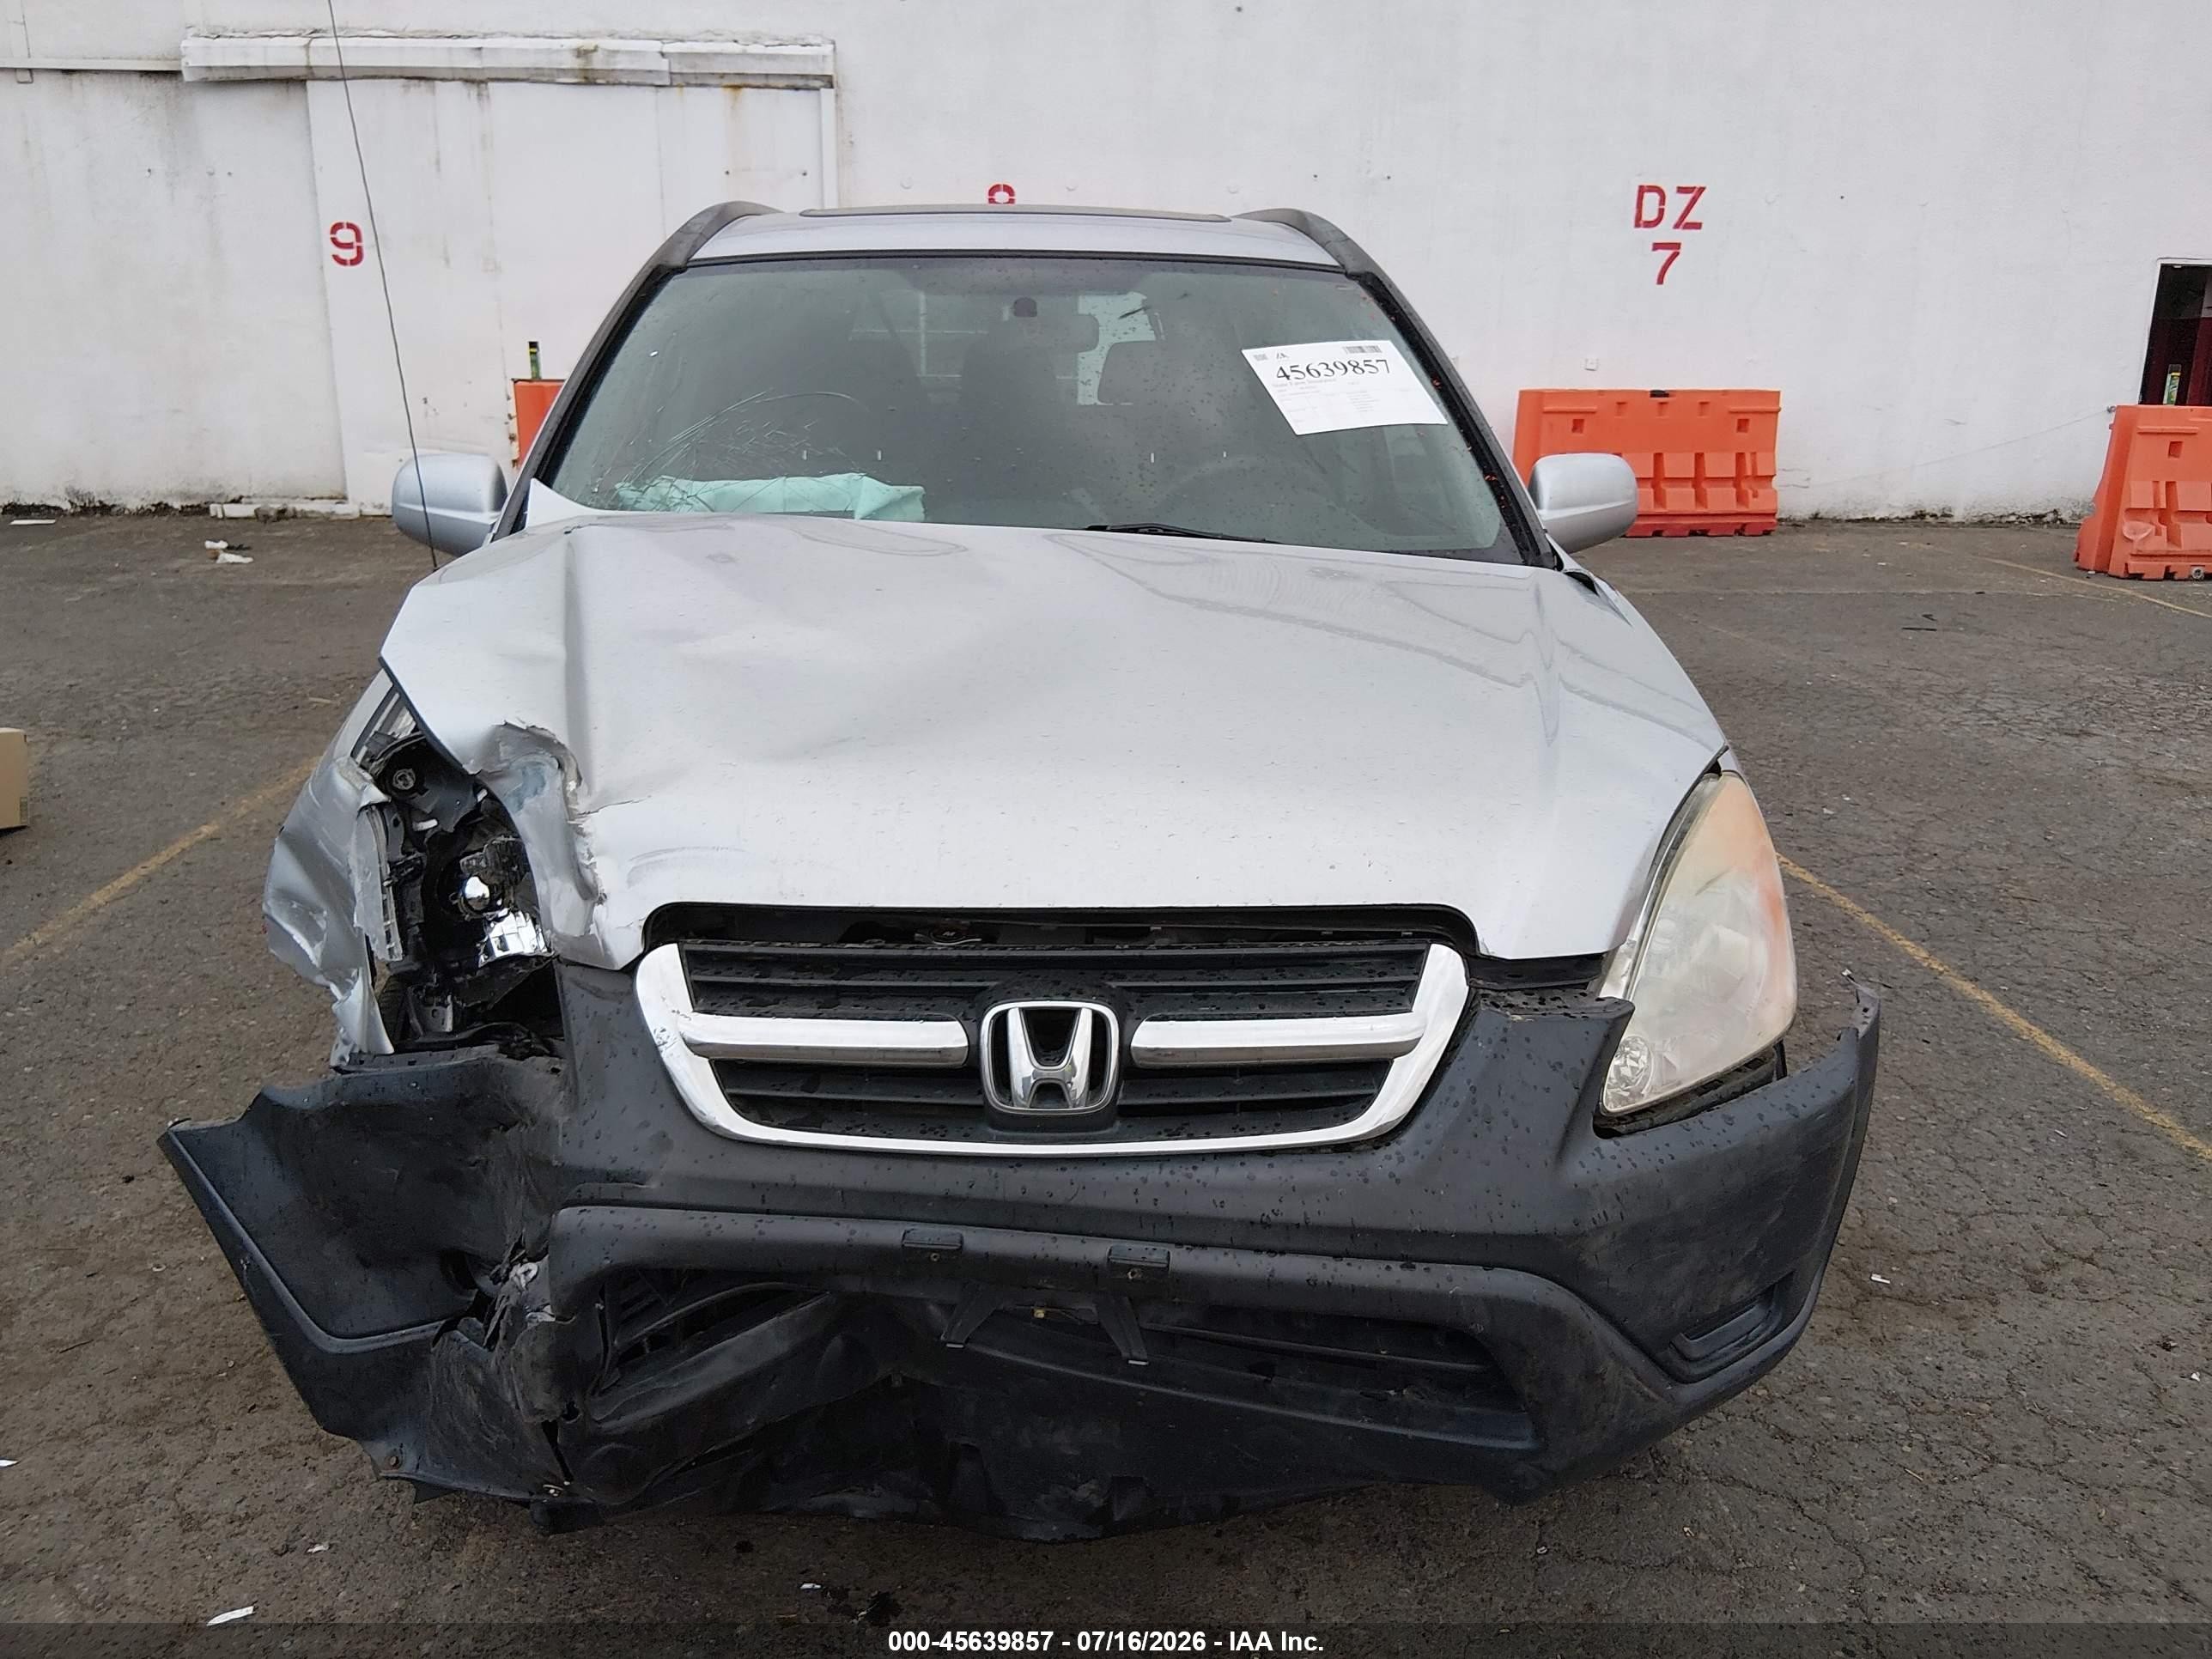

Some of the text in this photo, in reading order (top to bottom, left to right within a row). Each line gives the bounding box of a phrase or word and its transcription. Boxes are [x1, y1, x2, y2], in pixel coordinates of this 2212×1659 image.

[1634, 185, 1705, 230] DZ
[330, 222, 363, 265] 9
[1652, 241, 1681, 284] 7
[1276, 359, 1390, 380] 45639857
